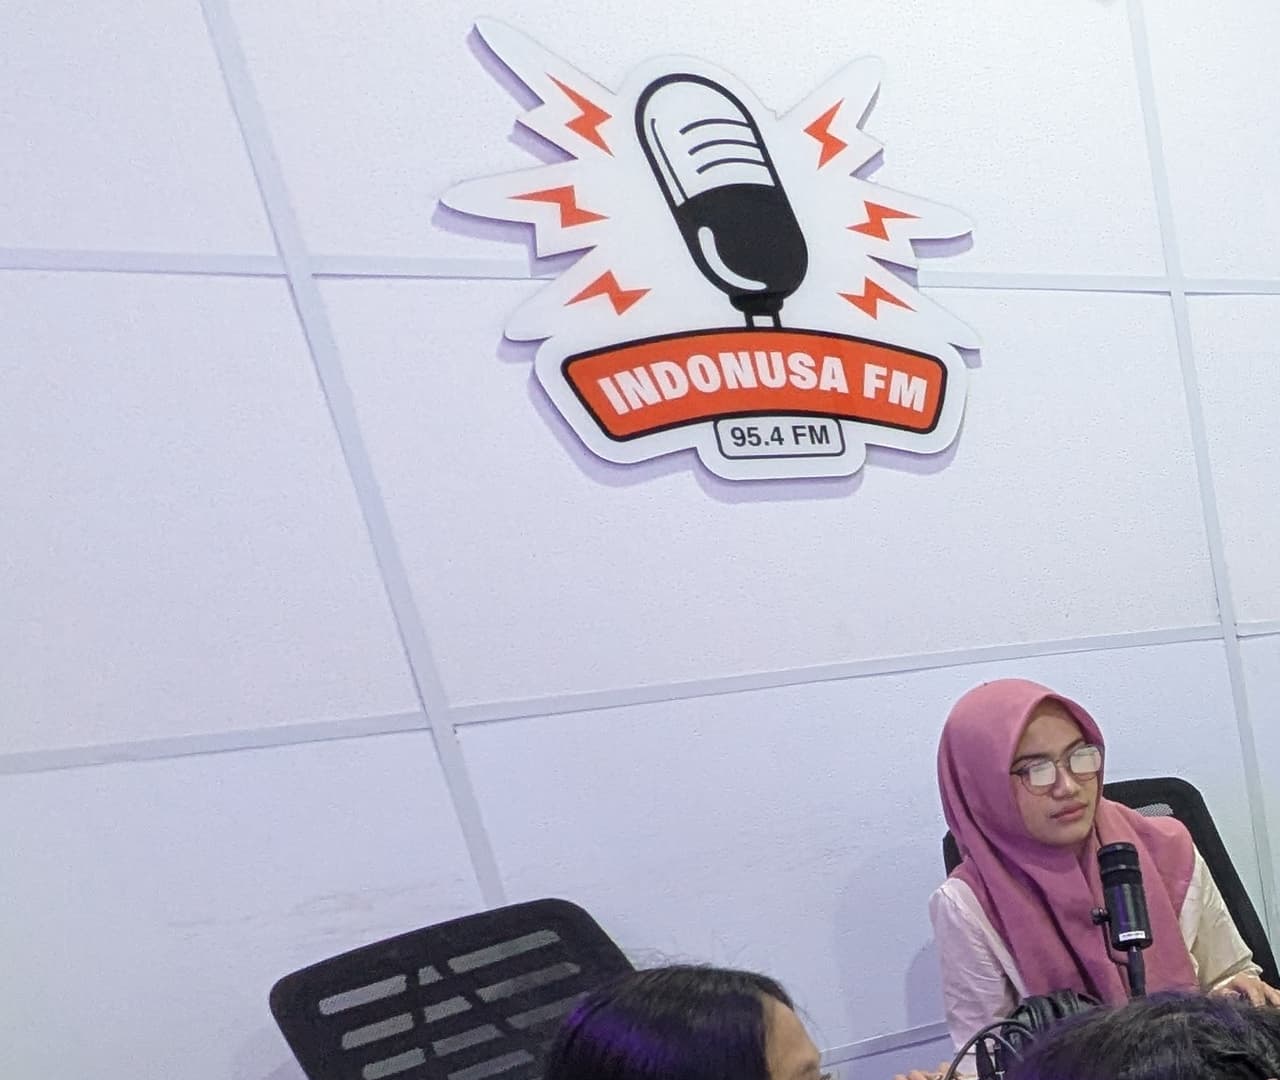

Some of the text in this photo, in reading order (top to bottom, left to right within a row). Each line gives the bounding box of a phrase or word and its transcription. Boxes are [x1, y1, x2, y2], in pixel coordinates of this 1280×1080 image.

[597, 352, 927, 416] INDONUSA FM
[731, 424, 830, 447] 95.4 FM
